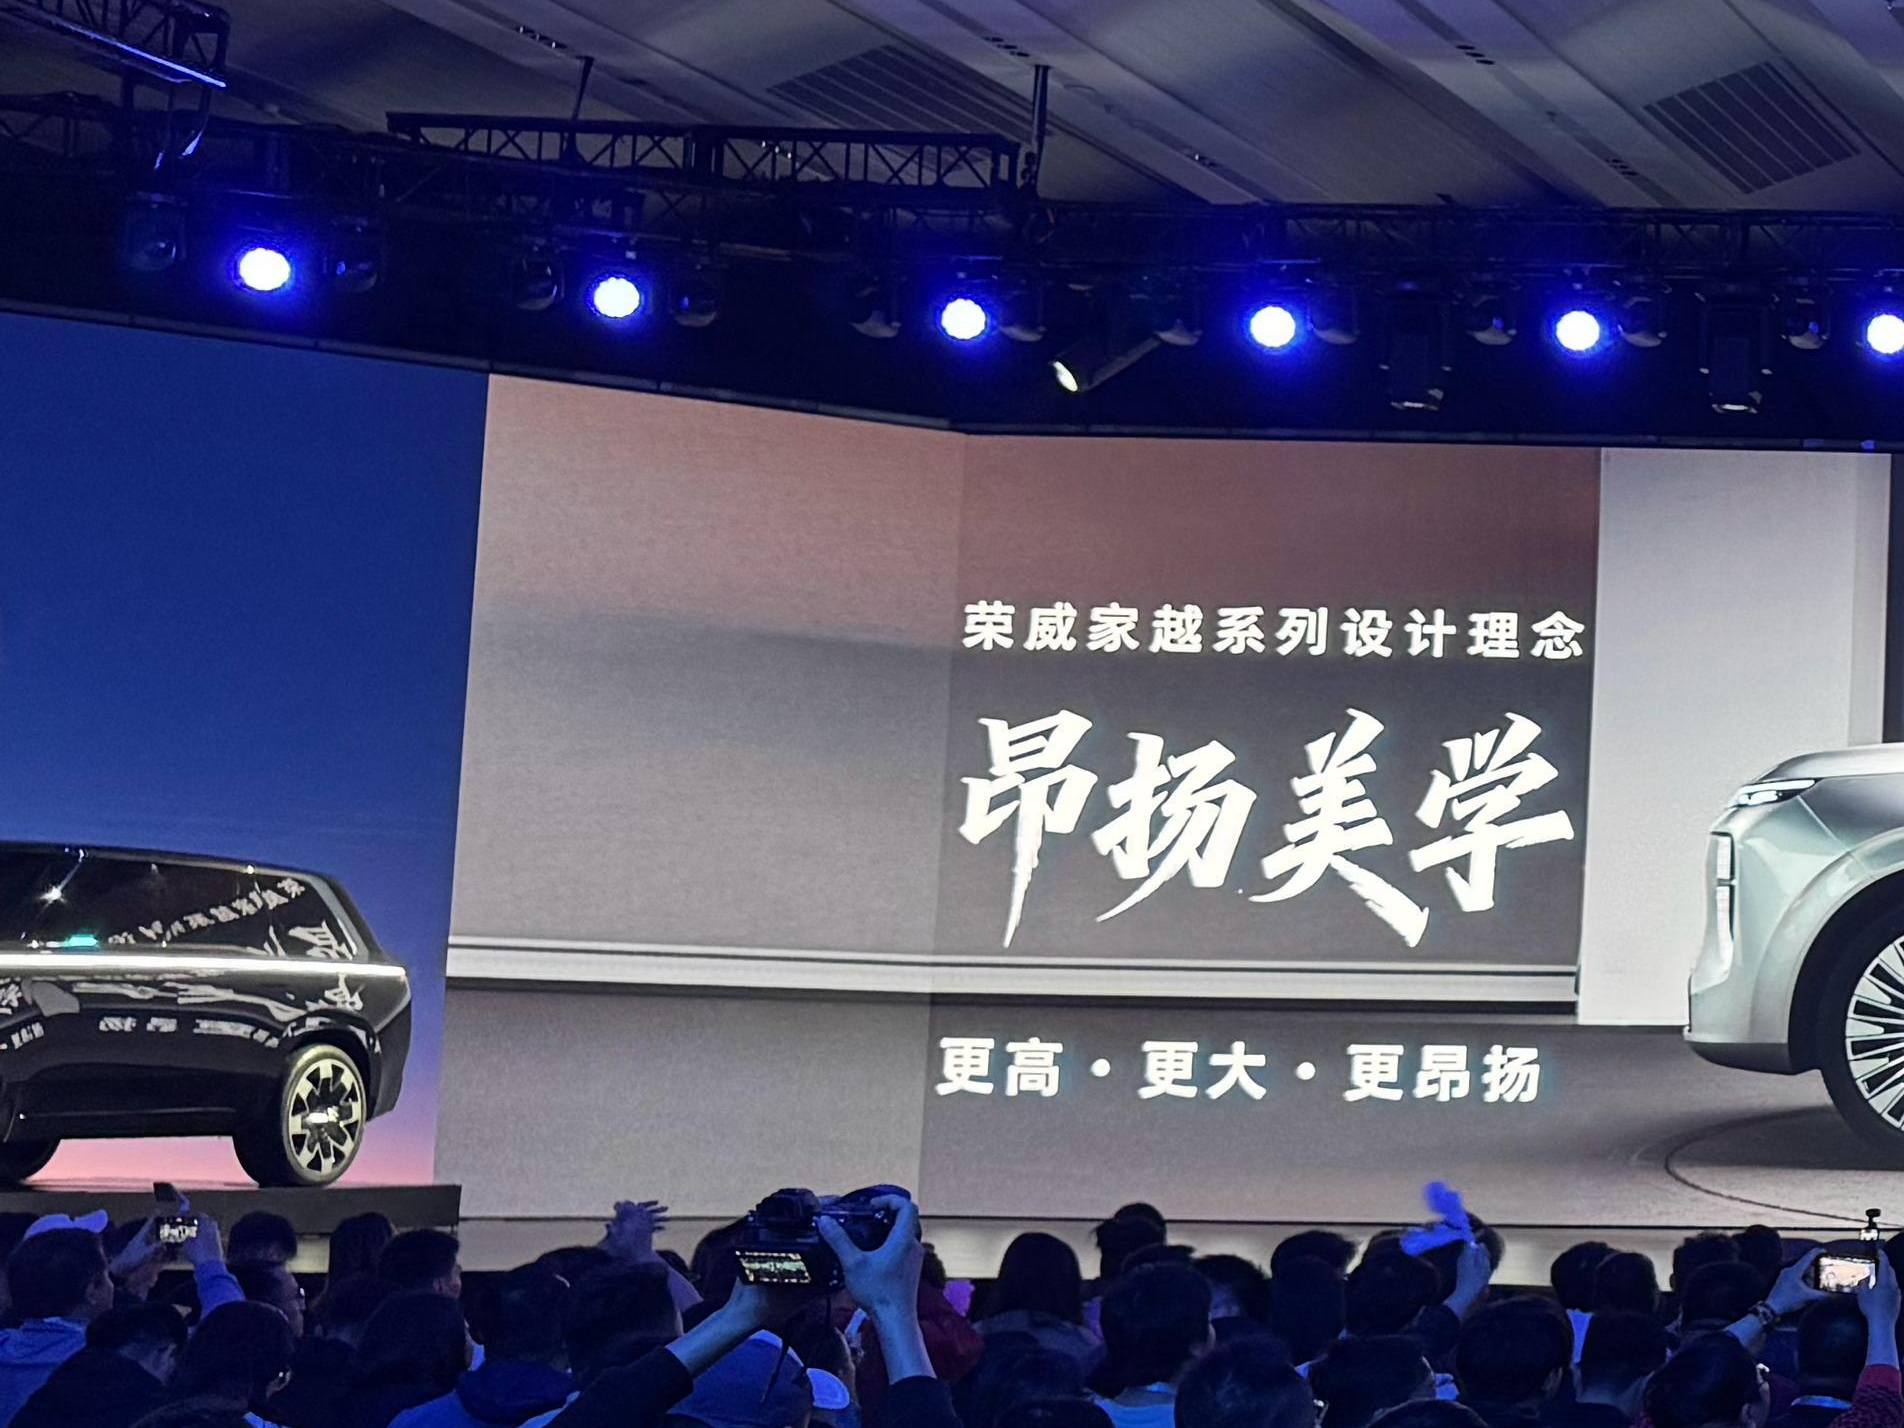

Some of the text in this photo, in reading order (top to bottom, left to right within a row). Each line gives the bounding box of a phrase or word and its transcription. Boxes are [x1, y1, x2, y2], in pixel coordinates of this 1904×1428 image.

[962, 599, 1586, 661] 荣威家越系列设计理念
[958, 708, 1575, 948] 昂扬美学
